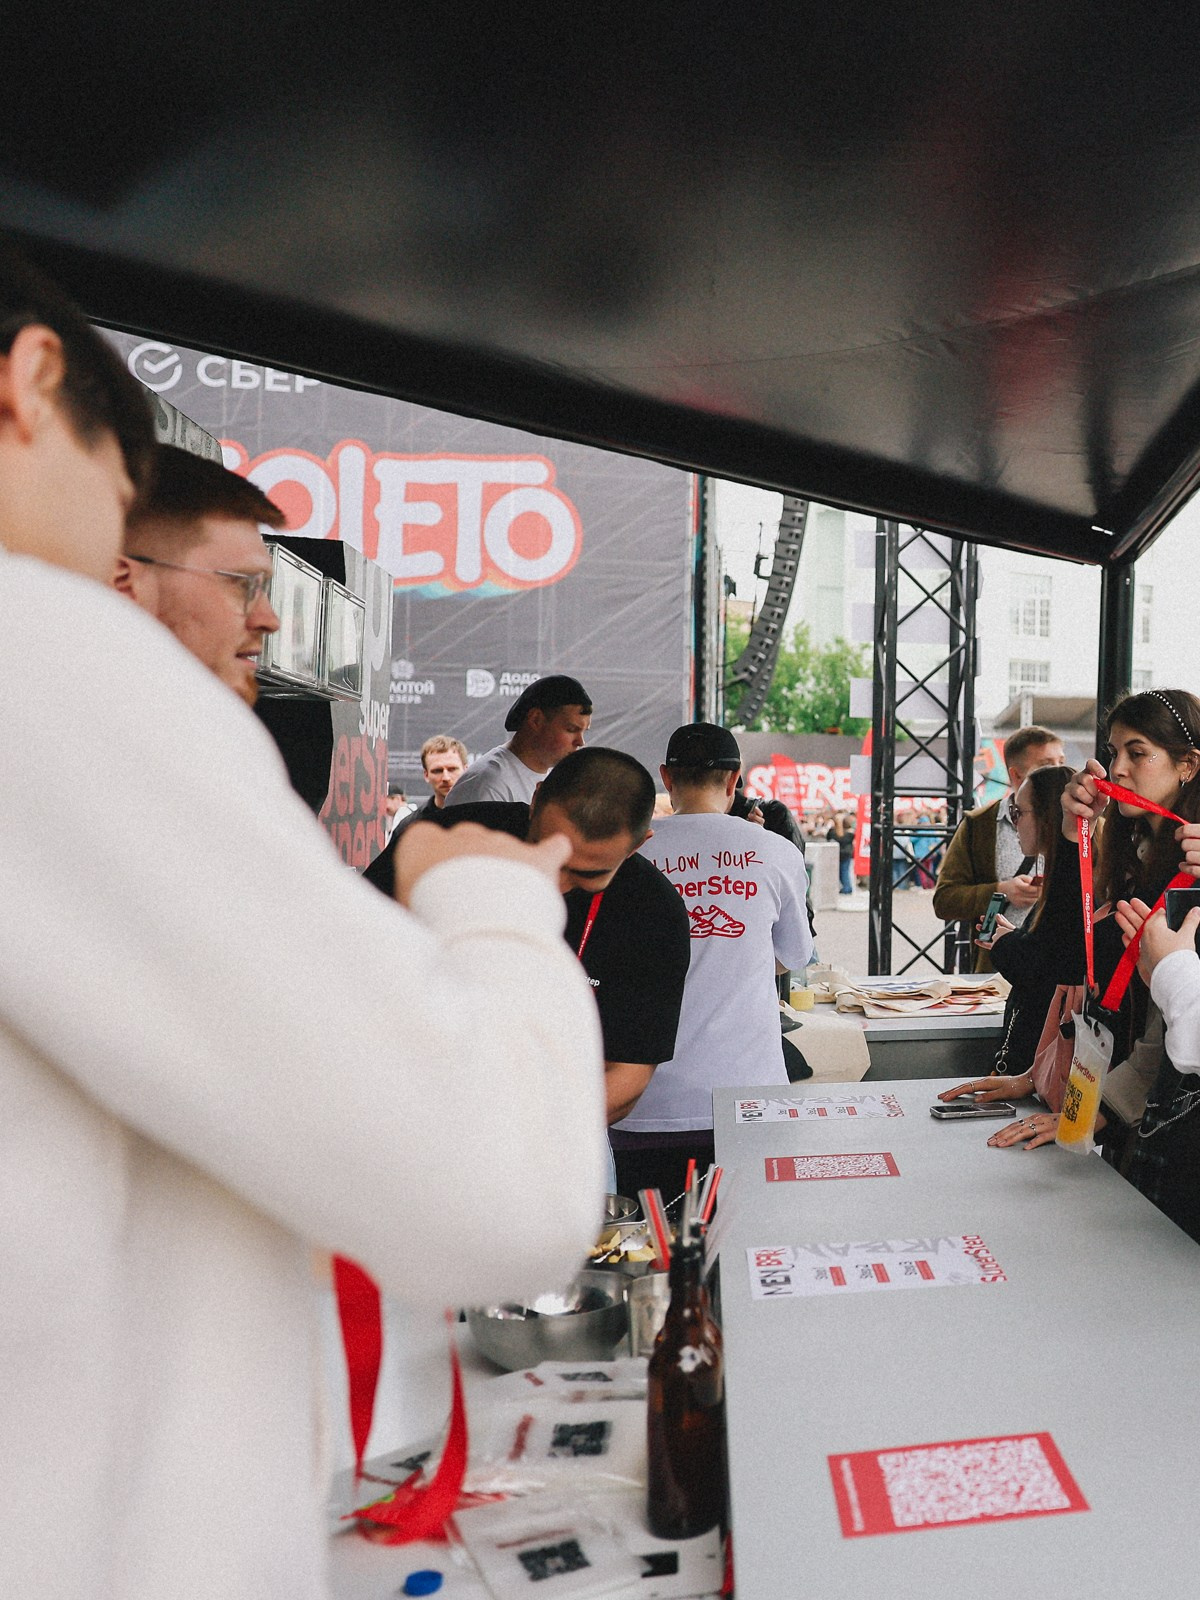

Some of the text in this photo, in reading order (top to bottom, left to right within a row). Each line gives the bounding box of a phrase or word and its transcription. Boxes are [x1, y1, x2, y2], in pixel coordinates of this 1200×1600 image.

[711, 850, 764, 870] YOUR
[1073, 1056, 1096, 1083] SuperStep
[961, 1235, 1008, 1282] SuperStep
